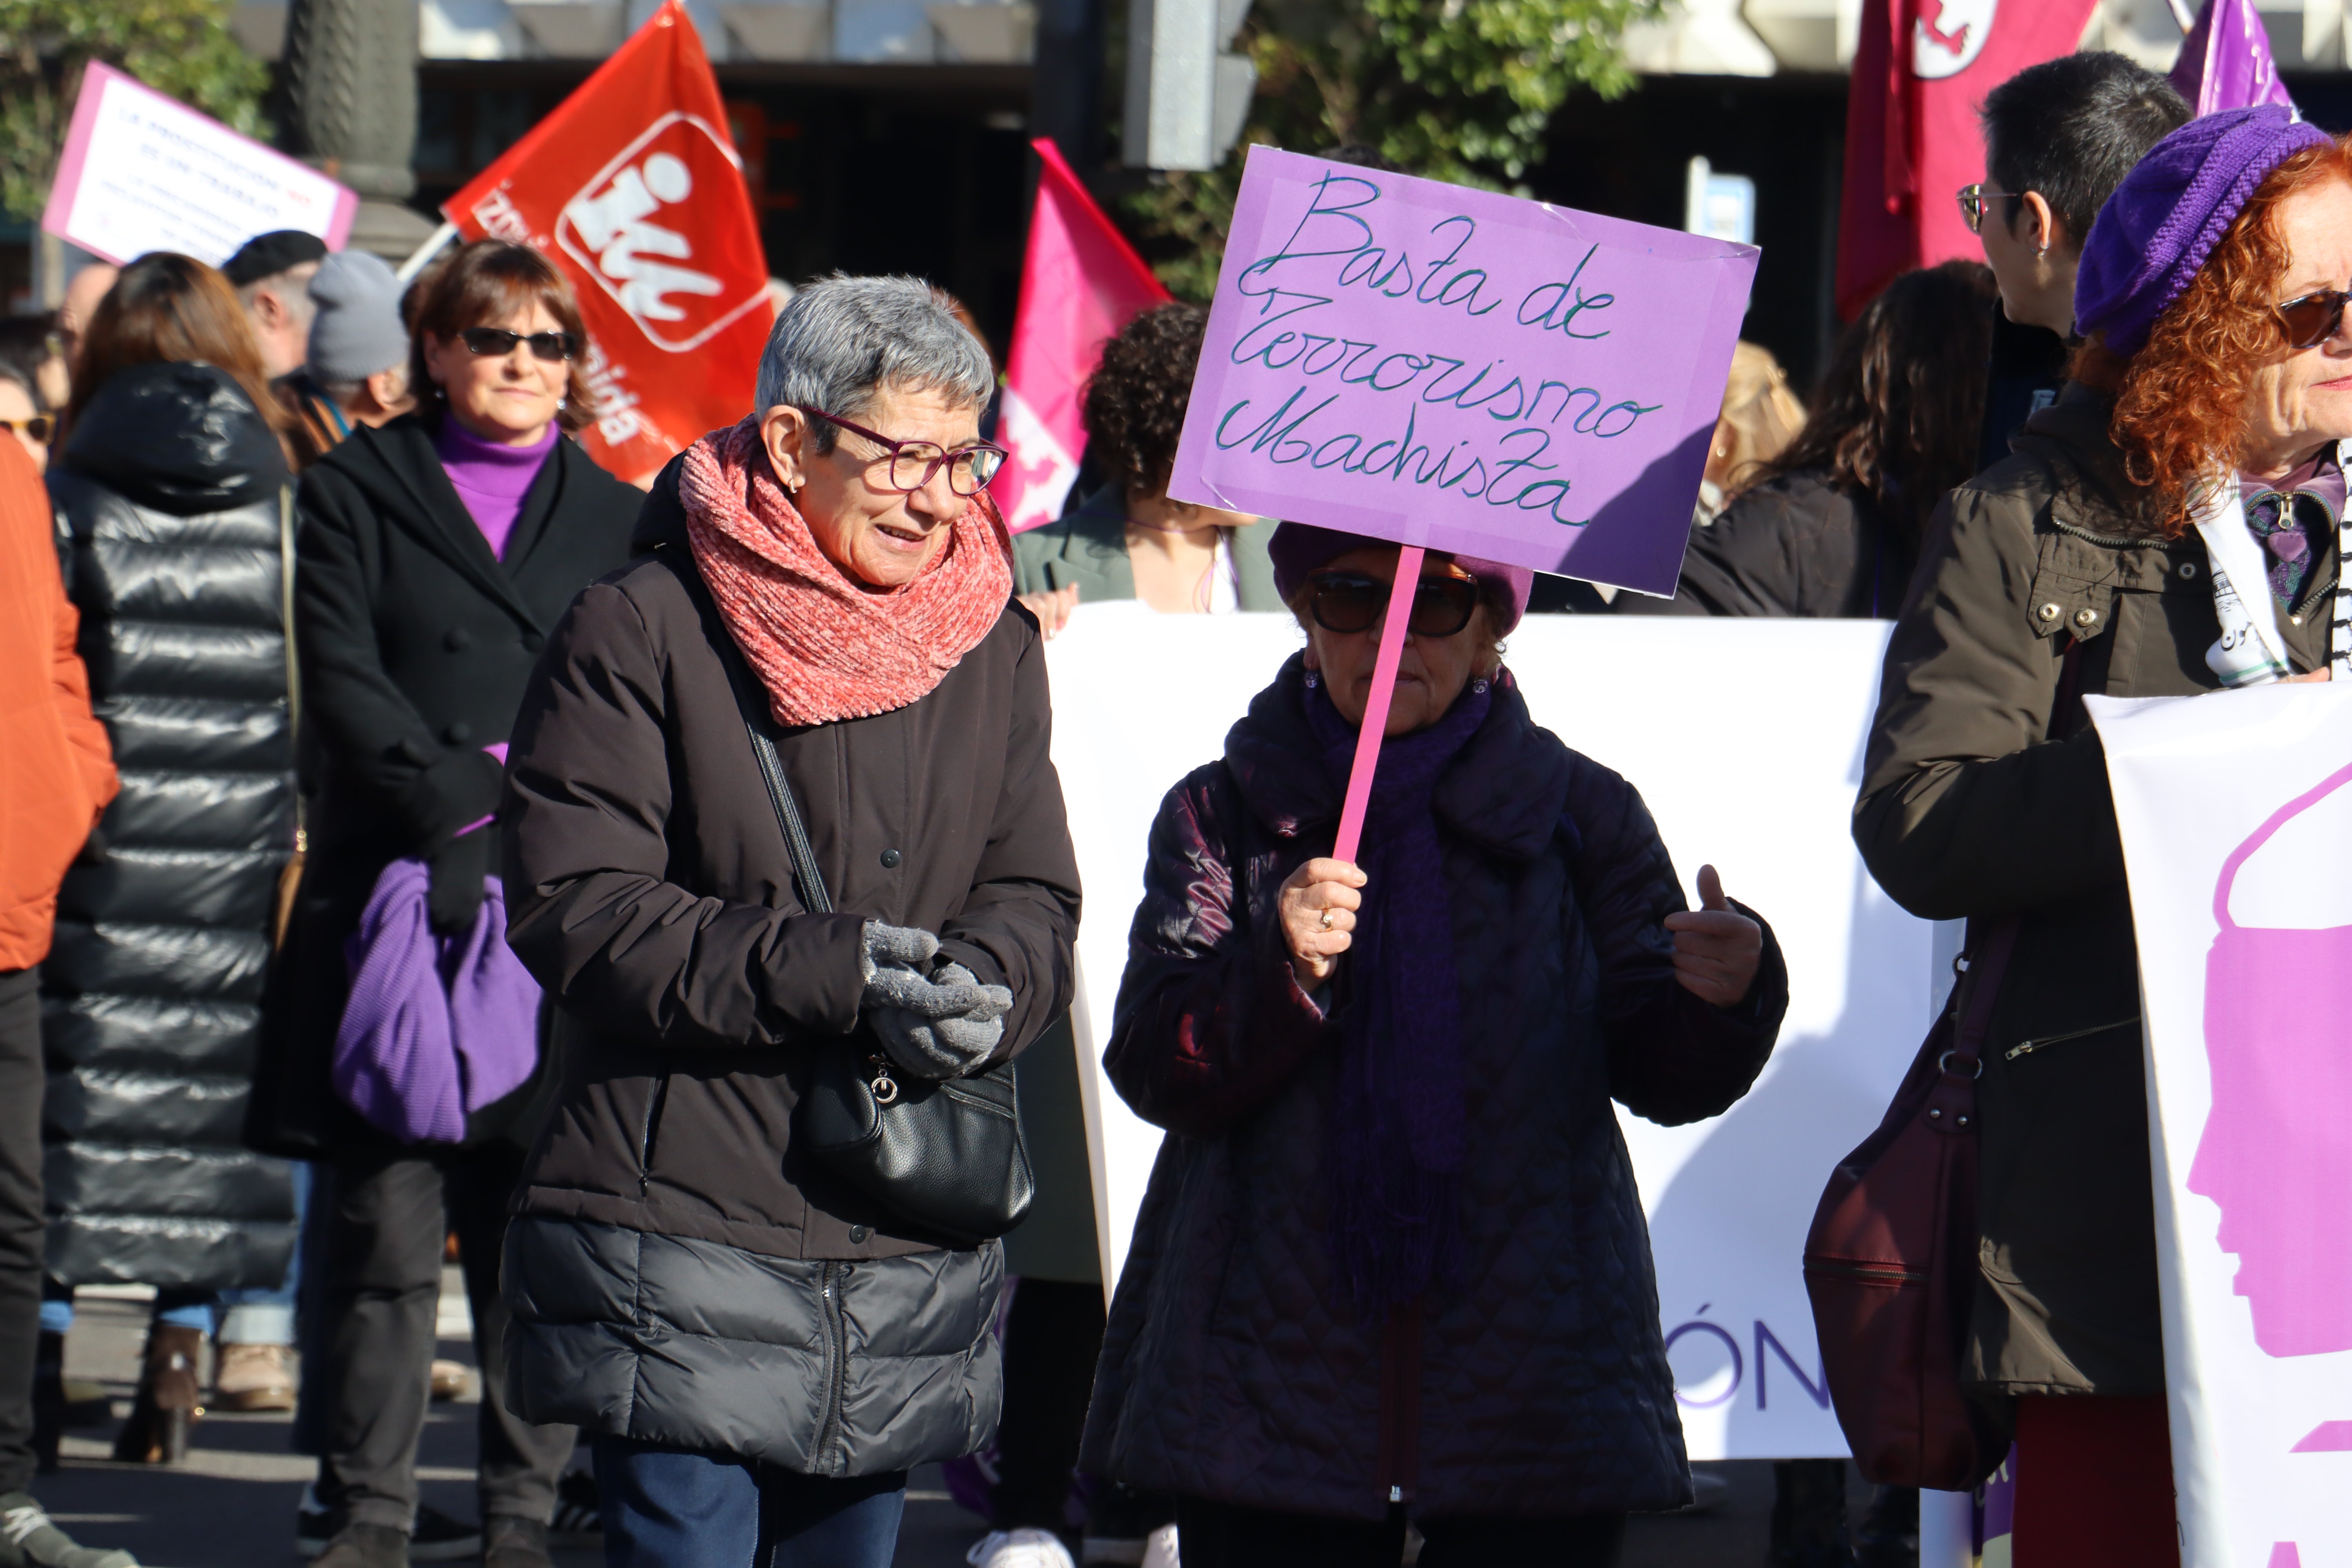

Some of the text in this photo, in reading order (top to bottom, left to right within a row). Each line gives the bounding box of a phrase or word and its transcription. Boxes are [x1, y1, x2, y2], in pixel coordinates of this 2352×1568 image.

[1239, 170, 1615, 339] Basta de
[1231, 288, 1663, 437] Terrorismo
[1216, 386, 1588, 527] Machista
